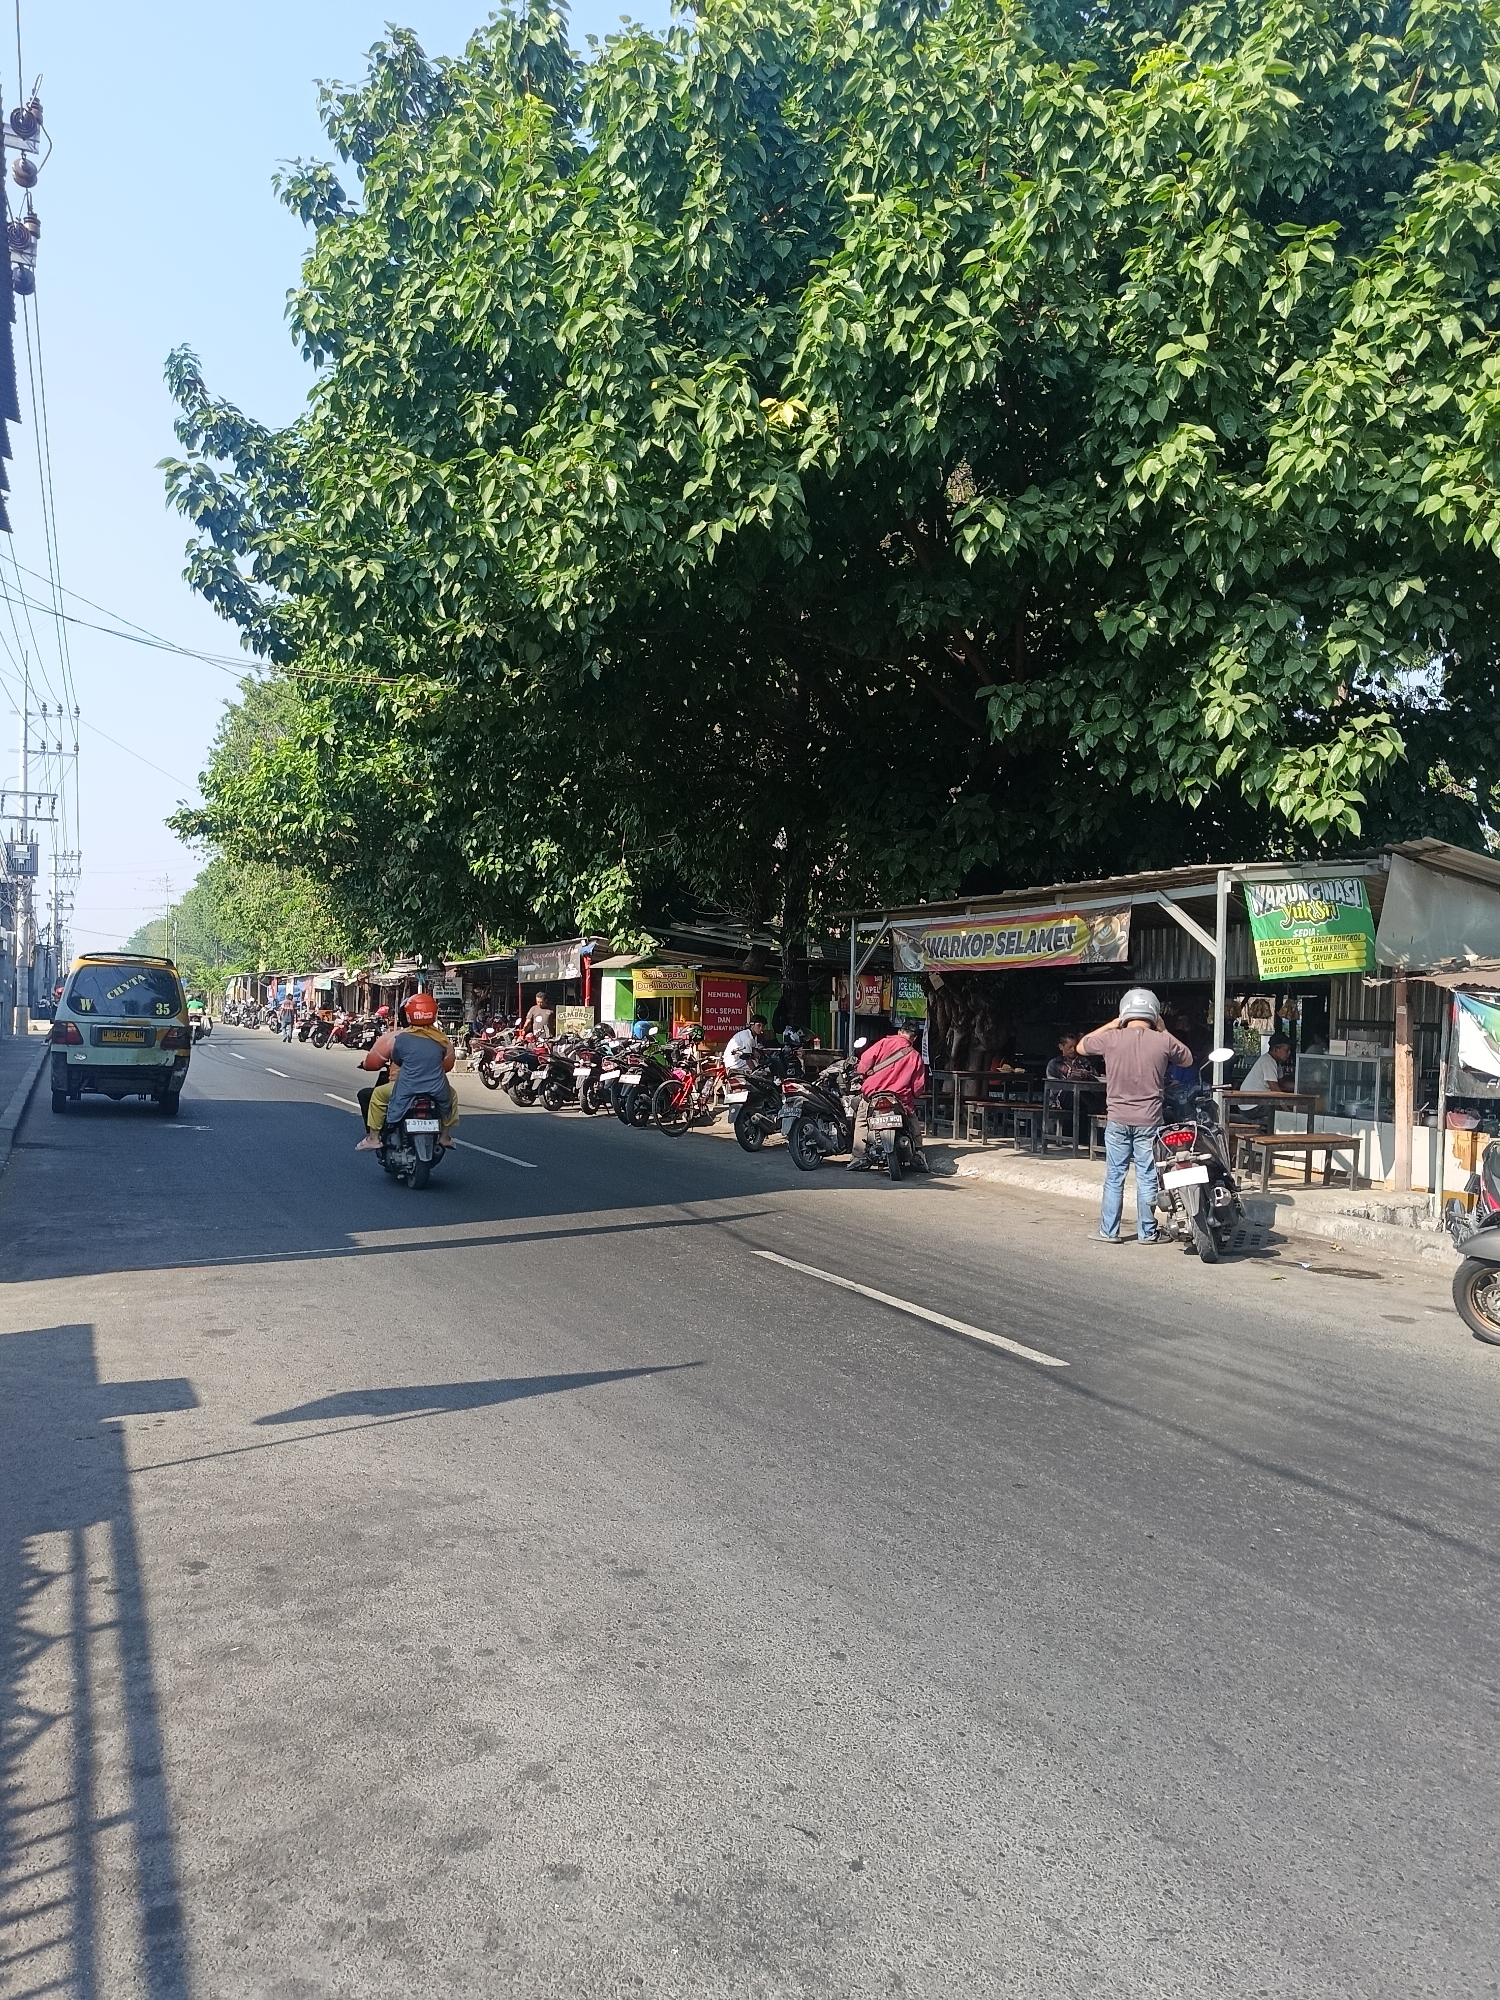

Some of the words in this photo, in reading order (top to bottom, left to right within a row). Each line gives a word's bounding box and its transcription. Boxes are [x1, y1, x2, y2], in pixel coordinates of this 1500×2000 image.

[1250, 881, 1321, 916] WARUNG
[1321, 879, 1362, 908] NASI
[1281, 900, 1312, 929] Yuk
[1311, 899, 1339, 923] Sri
[926, 932, 995, 960] WARKOP
[994, 925, 1077, 956] SELAMET
[1259, 940, 1275, 948] NASI
[1275, 938, 1301, 947] CAMPUR
[1333, 933, 1361, 943] TONGKOL
[1261, 949, 1277, 957] NASI
[1277, 947, 1295, 956] PECEL
[1311, 953, 1333, 962] SAYUR
[1333, 951, 1350, 960] ASEM
[1262, 957, 1279, 966] NASI
[1278, 956, 1299, 964] LODEH
[1314, 962, 1325, 970] DLL
[1263, 966, 1280, 974] NASI
[1280, 964, 1294, 973] SOP
[656, 970, 688, 980] Sepatu
[106, 974, 147, 1000] CHYTA
[636, 981, 673, 993] Duplikat
[865, 986, 881, 994] APEL
[707, 991, 741, 999] MENERIMA
[79, 998, 94, 1011] W
[155, 1002, 171, 1015] 35
[705, 1007, 719, 1015] SOL
[719, 1007, 743, 1015] SEPATU
[717, 1016, 731, 1024] DAN
[702, 1024, 728, 1032] DUPLIKAT
